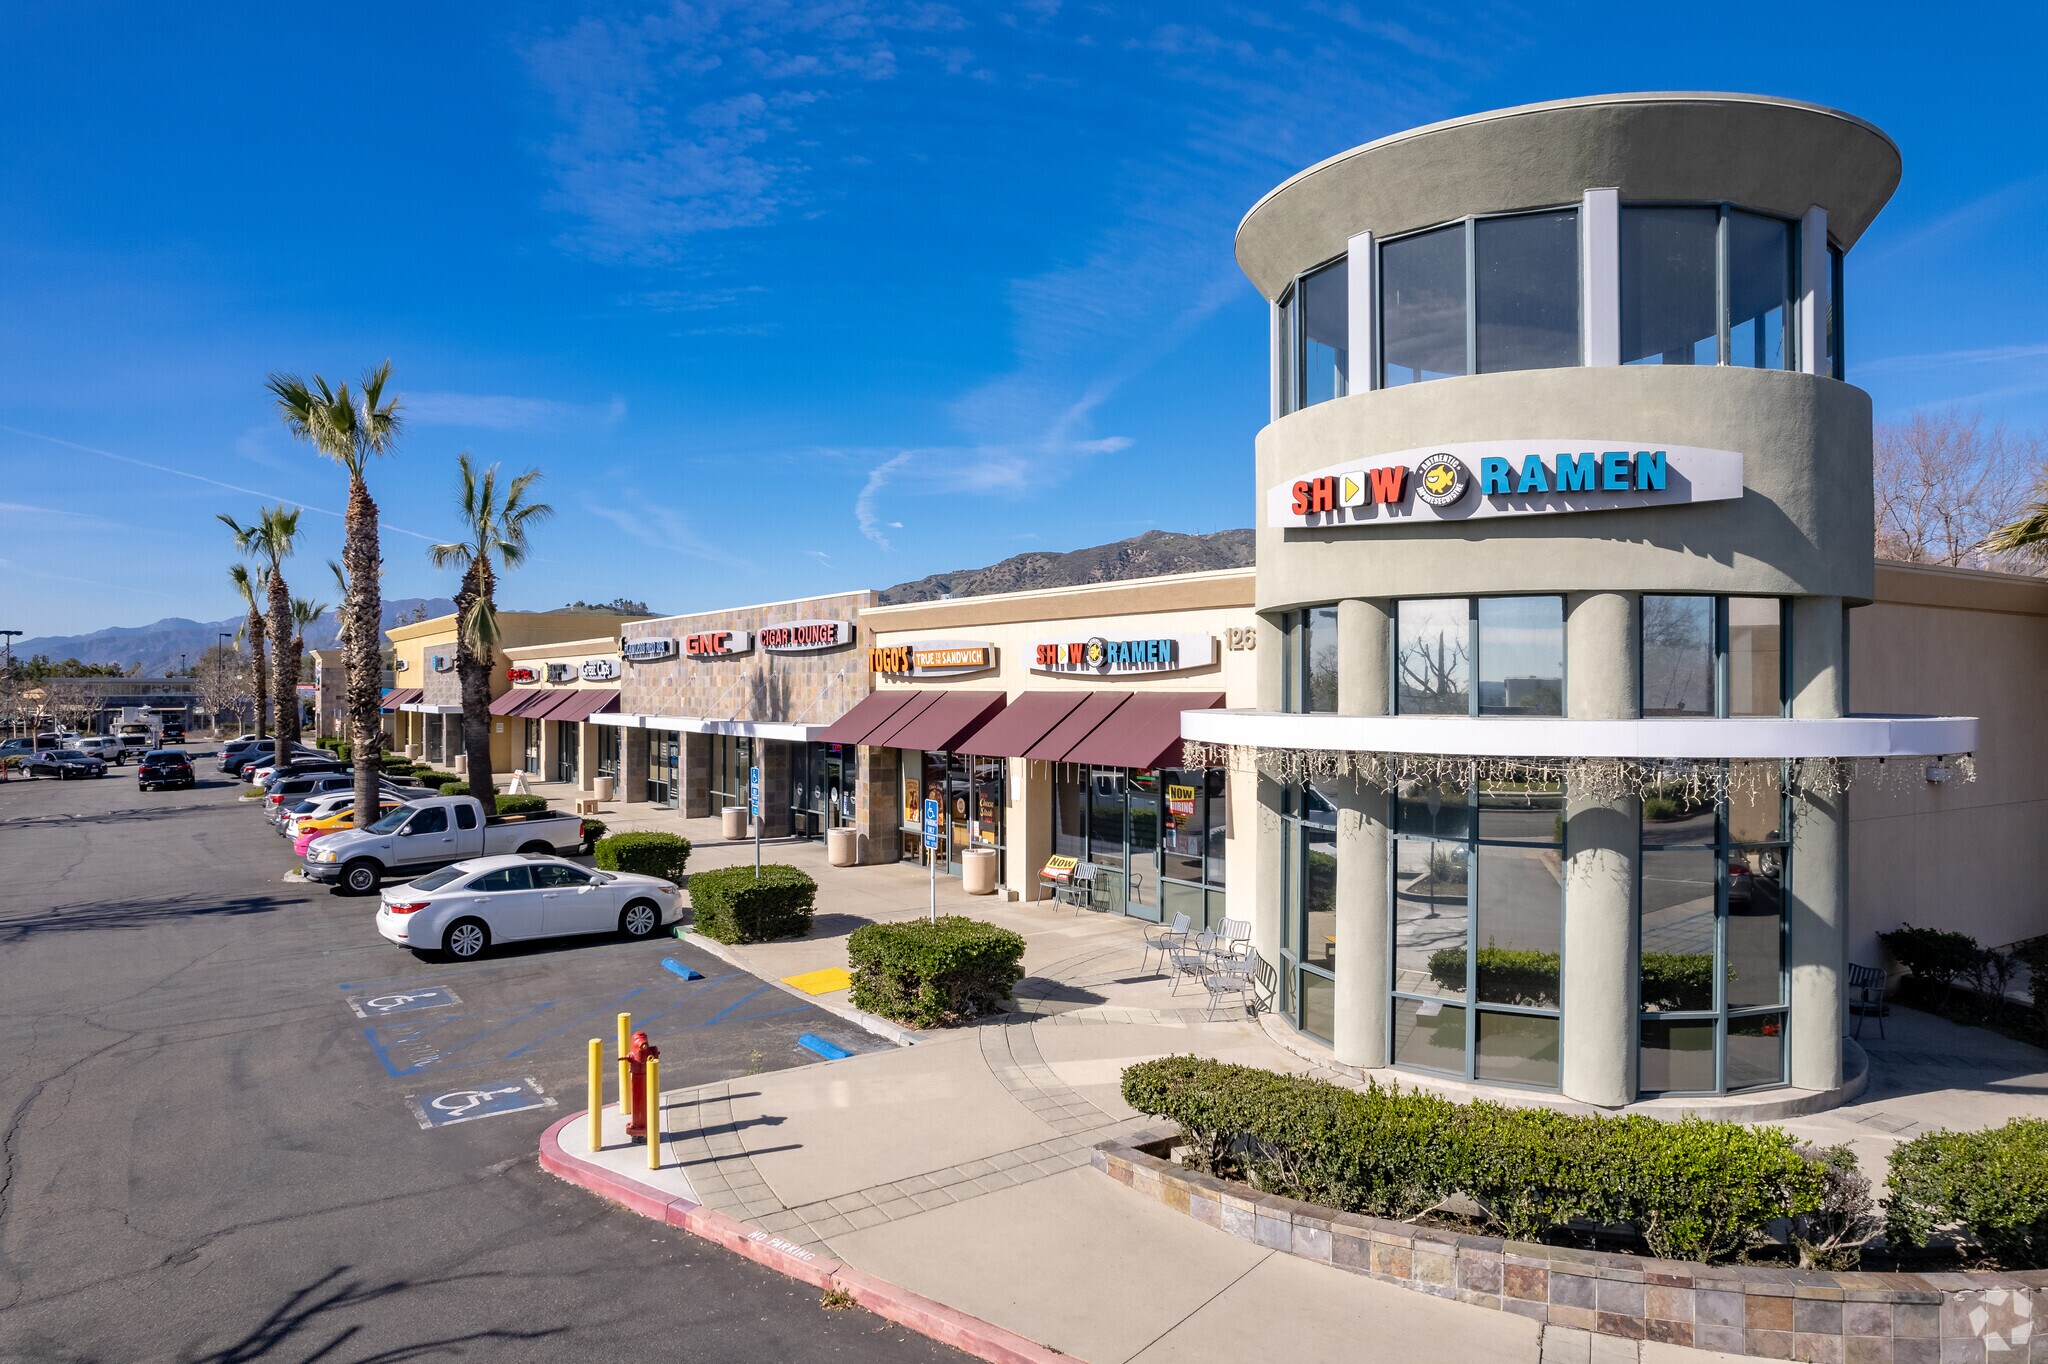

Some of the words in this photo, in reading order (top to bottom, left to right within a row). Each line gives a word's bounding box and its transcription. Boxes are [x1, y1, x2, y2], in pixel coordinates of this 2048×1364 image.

[1421, 454, 1460, 470] AUTHENTIC
[1481, 451, 1667, 496] RAMEN
[686, 632, 728, 654] GNC
[760, 628, 788, 646] CIGAR
[791, 623, 834, 645] LOUNGE
[1223, 626, 1257, 651] 126
[868, 646, 909, 673] TOGO'S
[916, 653, 935, 665] TRUE
[942, 650, 983, 665] SANDWICH
[1107, 639, 1171, 663] RAMEN
[1170, 786, 1193, 799] NOW
[1170, 801, 1194, 815] HIRING
[1050, 856, 1075, 868] NOW
[748, 1231, 767, 1241] NO
[768, 1238, 816, 1260] PARKING
